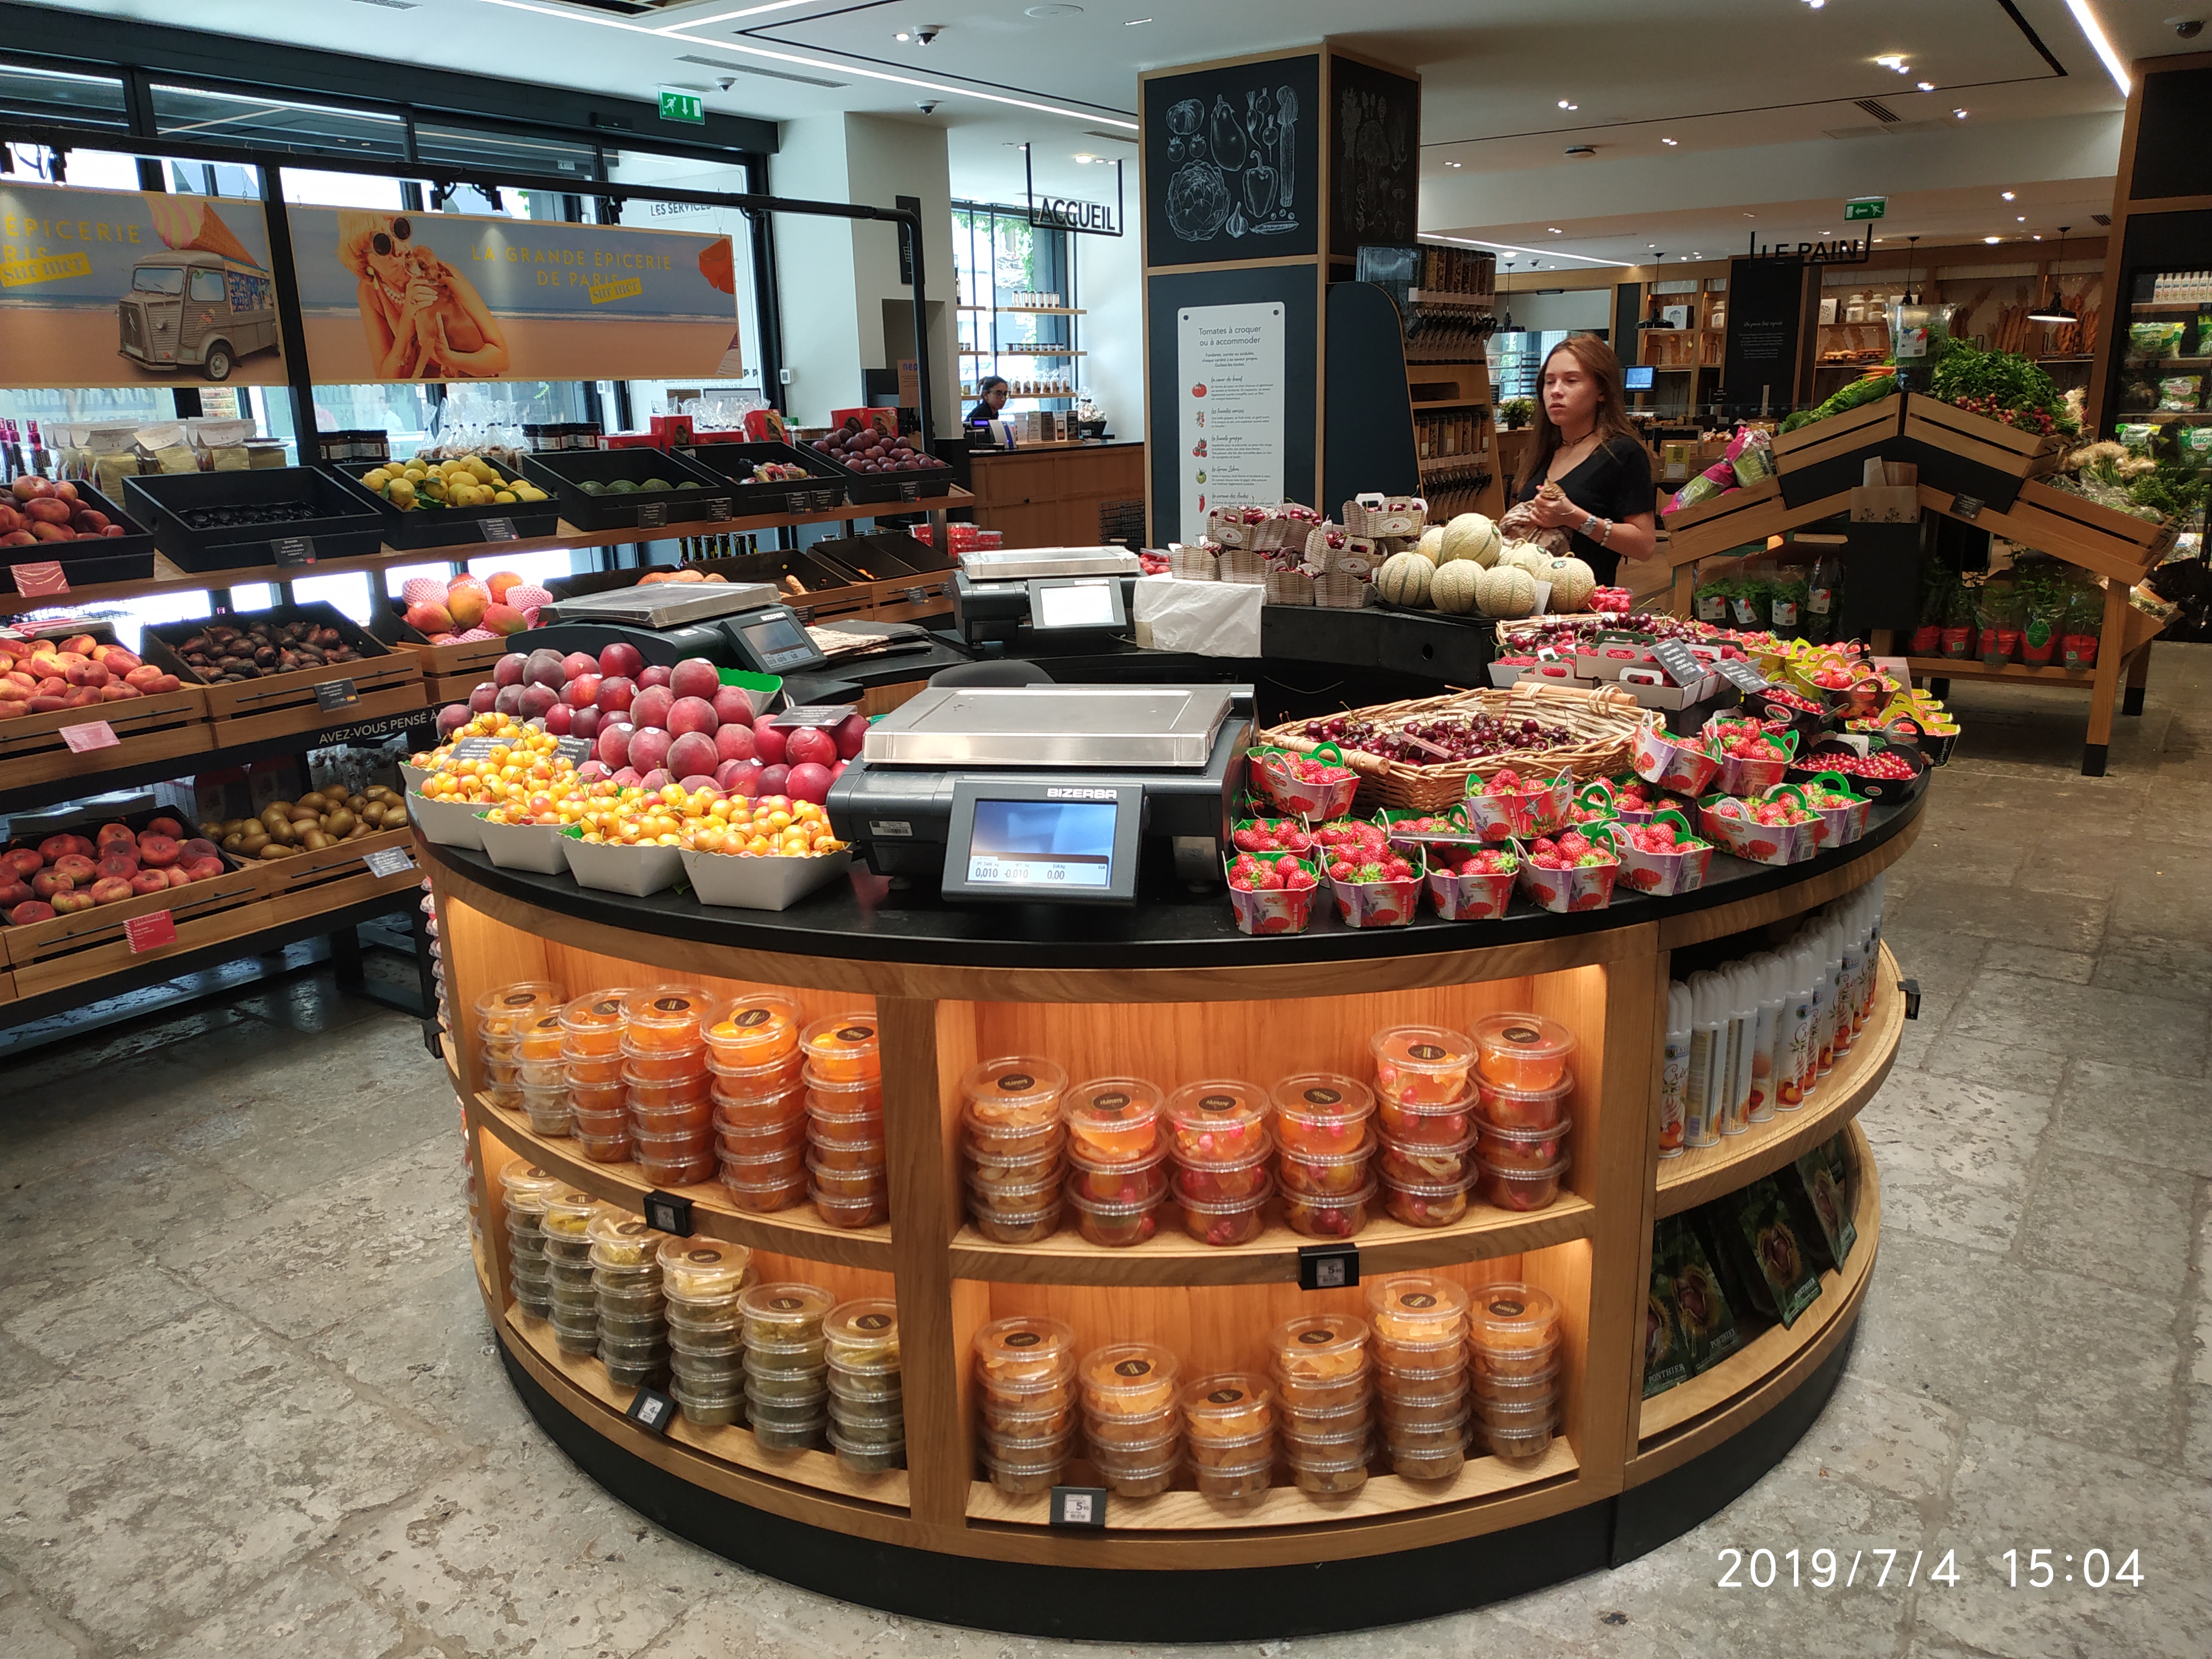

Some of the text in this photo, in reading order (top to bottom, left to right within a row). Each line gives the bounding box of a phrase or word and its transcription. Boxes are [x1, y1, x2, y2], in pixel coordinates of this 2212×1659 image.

[650, 204, 666, 216] LES
[1039, 197, 1115, 231] ACCUEIL
[4, 212, 142, 244] ÉPICERIE
[472, 245, 672, 270] LA GRANDE ÉPICERIE
[1797, 239, 1858, 262] PAIN
[3, 258, 83, 281] sur mer
[537, 270, 619, 288] DE PARIS
[592, 281, 639, 300] sur mer
[1198, 327, 1227, 336] Tomates
[1234, 326, 1261, 335] croquer
[1215, 336, 1261, 346] accommoder
[1767, 708, 1790, 719] TRUVAL
[319, 709, 438, 745] AVEZ-VOUS PENSÉ À
[1660, 745, 1668, 758] Bois
[1047, 788, 1117, 799] BIZERBA
[975, 867, 1065, 880] 0,010 -0,010 0,00
[1328, 1265, 1335, 1274] 5
[1794, 1277, 1817, 1300] PONTHIER
[1710, 1328, 1736, 1348] PONTHIER
[1648, 1363, 1686, 1383] PONTHIER
[1076, 1502, 1083, 1511] 5
